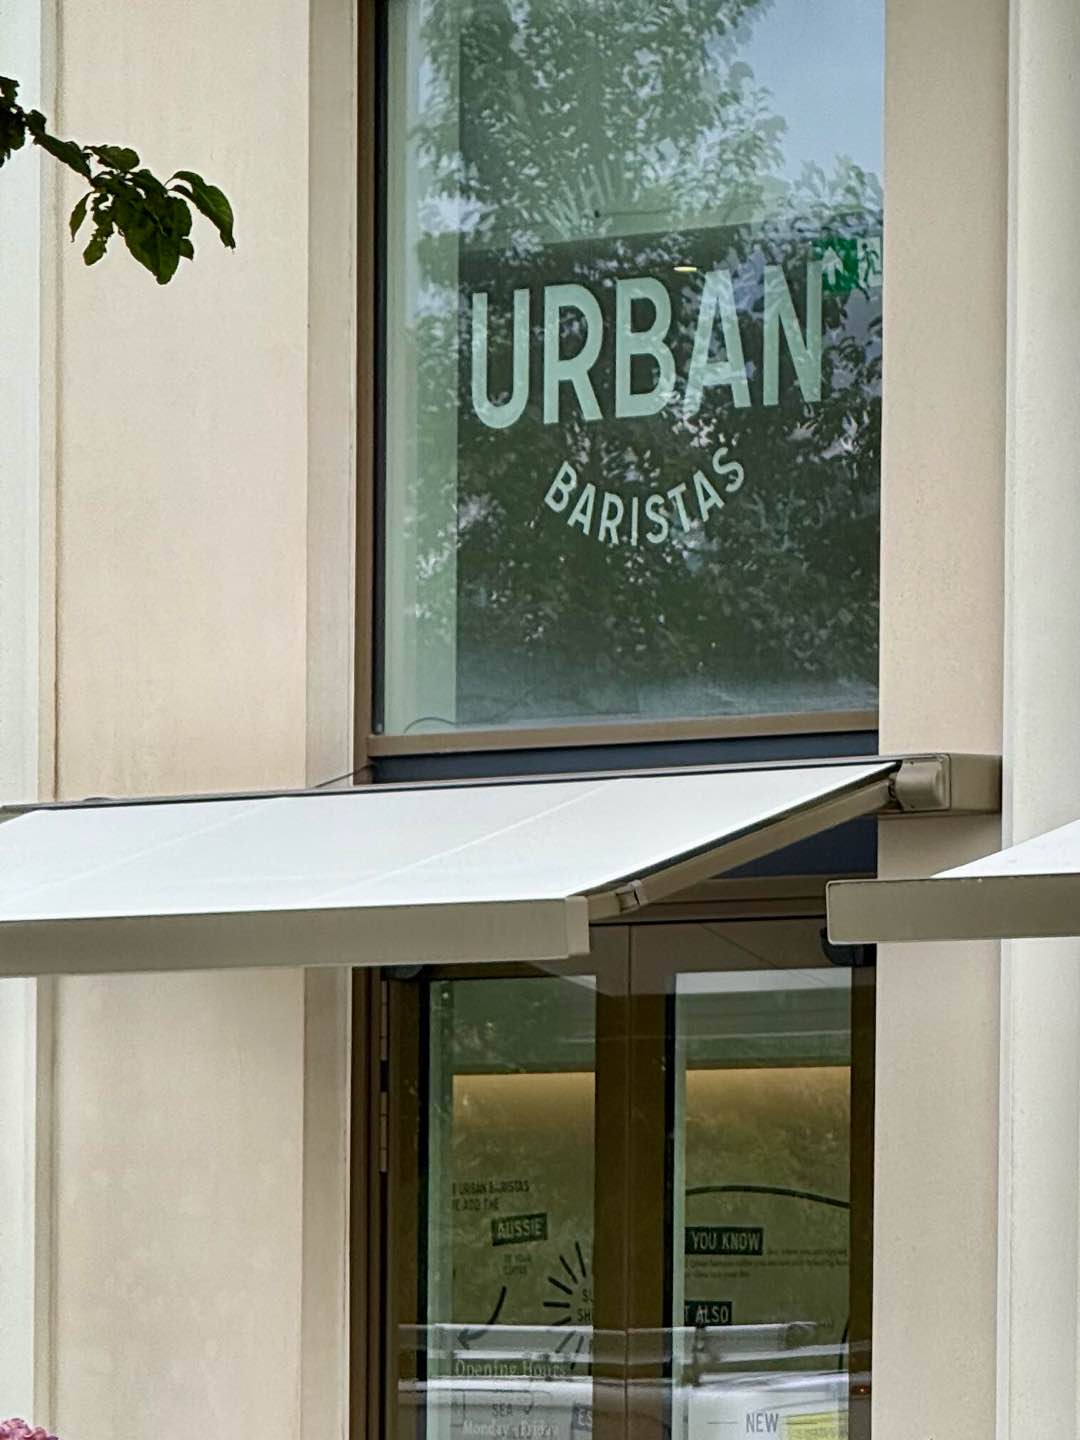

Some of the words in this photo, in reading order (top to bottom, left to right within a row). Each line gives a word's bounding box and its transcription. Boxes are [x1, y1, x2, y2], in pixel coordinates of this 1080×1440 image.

[471, 264, 822, 429] URBAN
[544, 446, 746, 546] BARISTAS
[497, 1217, 544, 1240] AUSSIE
[692, 1232, 718, 1250] YOU
[721, 1231, 761, 1250] KNOW
[695, 1304, 729, 1324] ALSO
[455, 1359, 516, 1379] Opening
[463, 1418, 509, 1438] Monday
[745, 1412, 779, 1433] NEW
